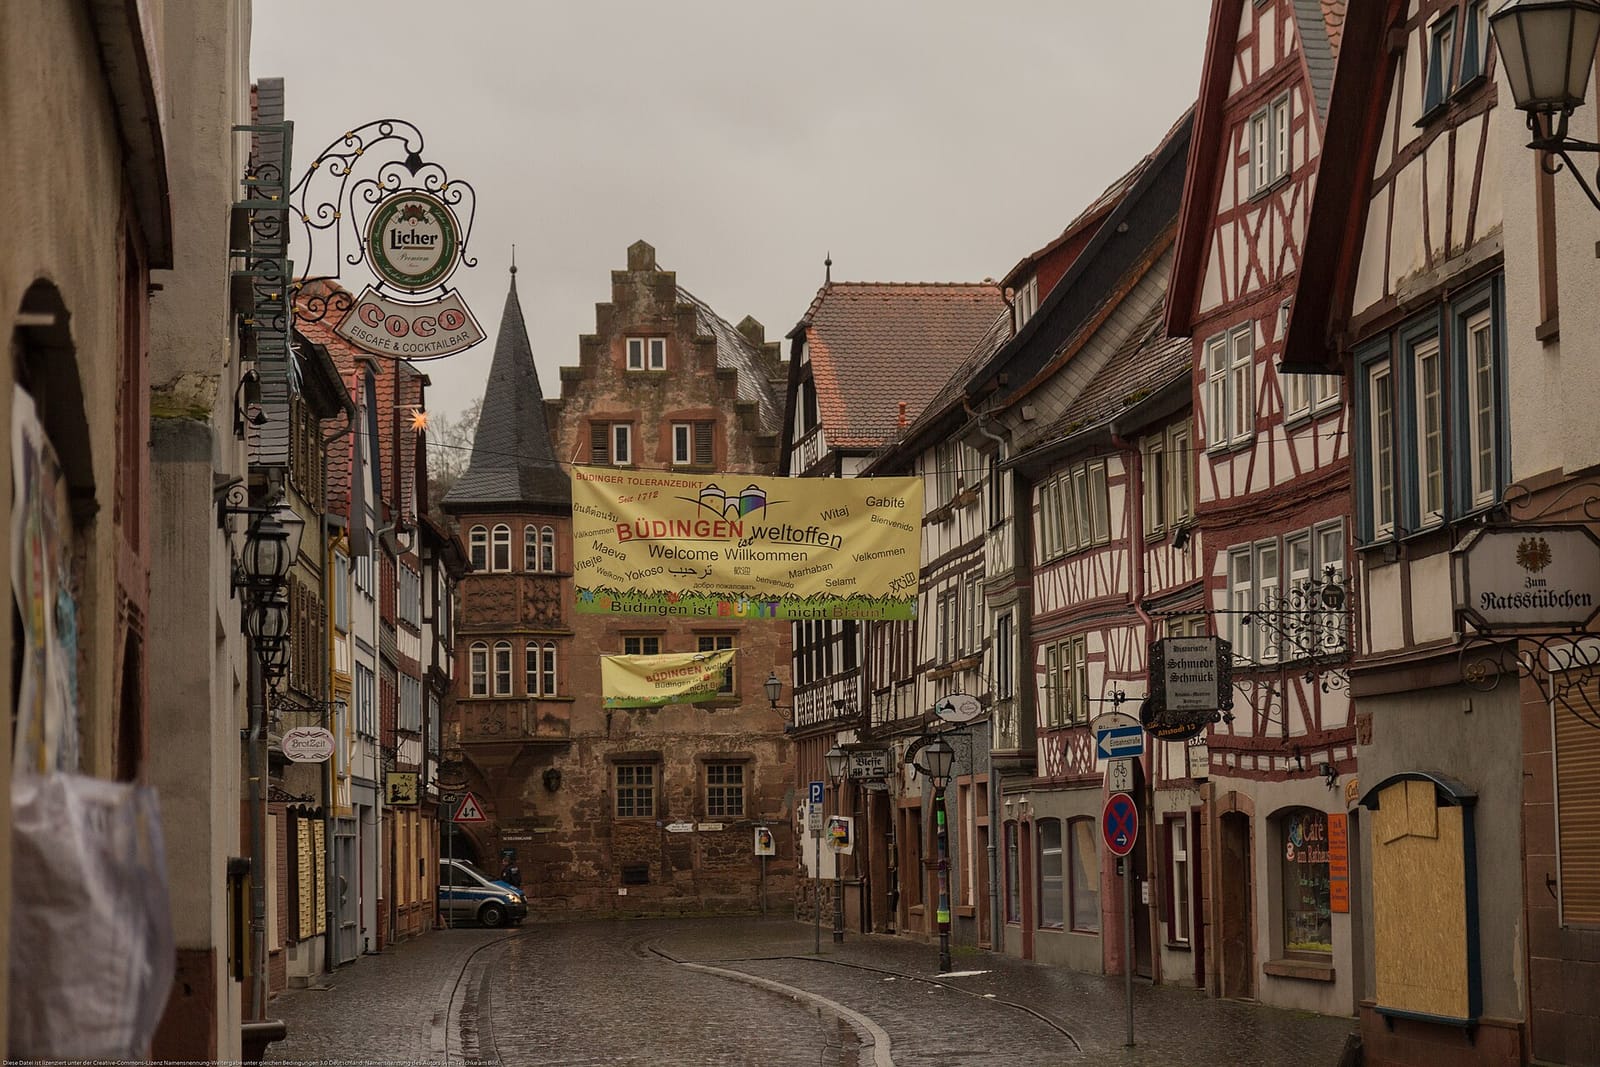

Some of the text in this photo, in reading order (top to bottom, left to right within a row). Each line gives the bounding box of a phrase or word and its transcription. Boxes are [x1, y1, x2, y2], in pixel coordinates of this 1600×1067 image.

[390, 229, 438, 250] Licher
[358, 302, 466, 338] COCO
[350, 326, 471, 353] EISCAFÉ & COCKTAILBAR
[576, 472, 703, 489] BÜDINGER TOLERANZEDIKT
[637, 490, 660, 500] 1712
[866, 496, 905, 509] Gabité
[820, 505, 849, 522] Witaj
[871, 514, 914, 533] Bienvenido
[616, 517, 843, 549] BÜDINGEN ist weltoffen
[592, 540, 627, 562] Maeva
[648, 544, 808, 561] Welcome Willkommen
[852, 546, 906, 563] Velkommen
[574, 554, 603, 572] Vitejte
[788, 562, 834, 579] Marhaban
[596, 566, 624, 583] Welkom
[625, 565, 664, 581] Yokoso
[825, 577, 857, 587] Selamt
[1525, 576, 1547, 589] Zum
[1480, 589, 1592, 610] Ratsstübchen
[611, 601, 687, 617] Büdingen
[693, 602, 713, 616] ist
[718, 600, 780, 617] BUNT
[788, 607, 828, 618] nicht
[1167, 658, 1214, 670] Schmiede
[645, 665, 702, 683] BÜDINGEN
[812, 785, 820, 804] P
